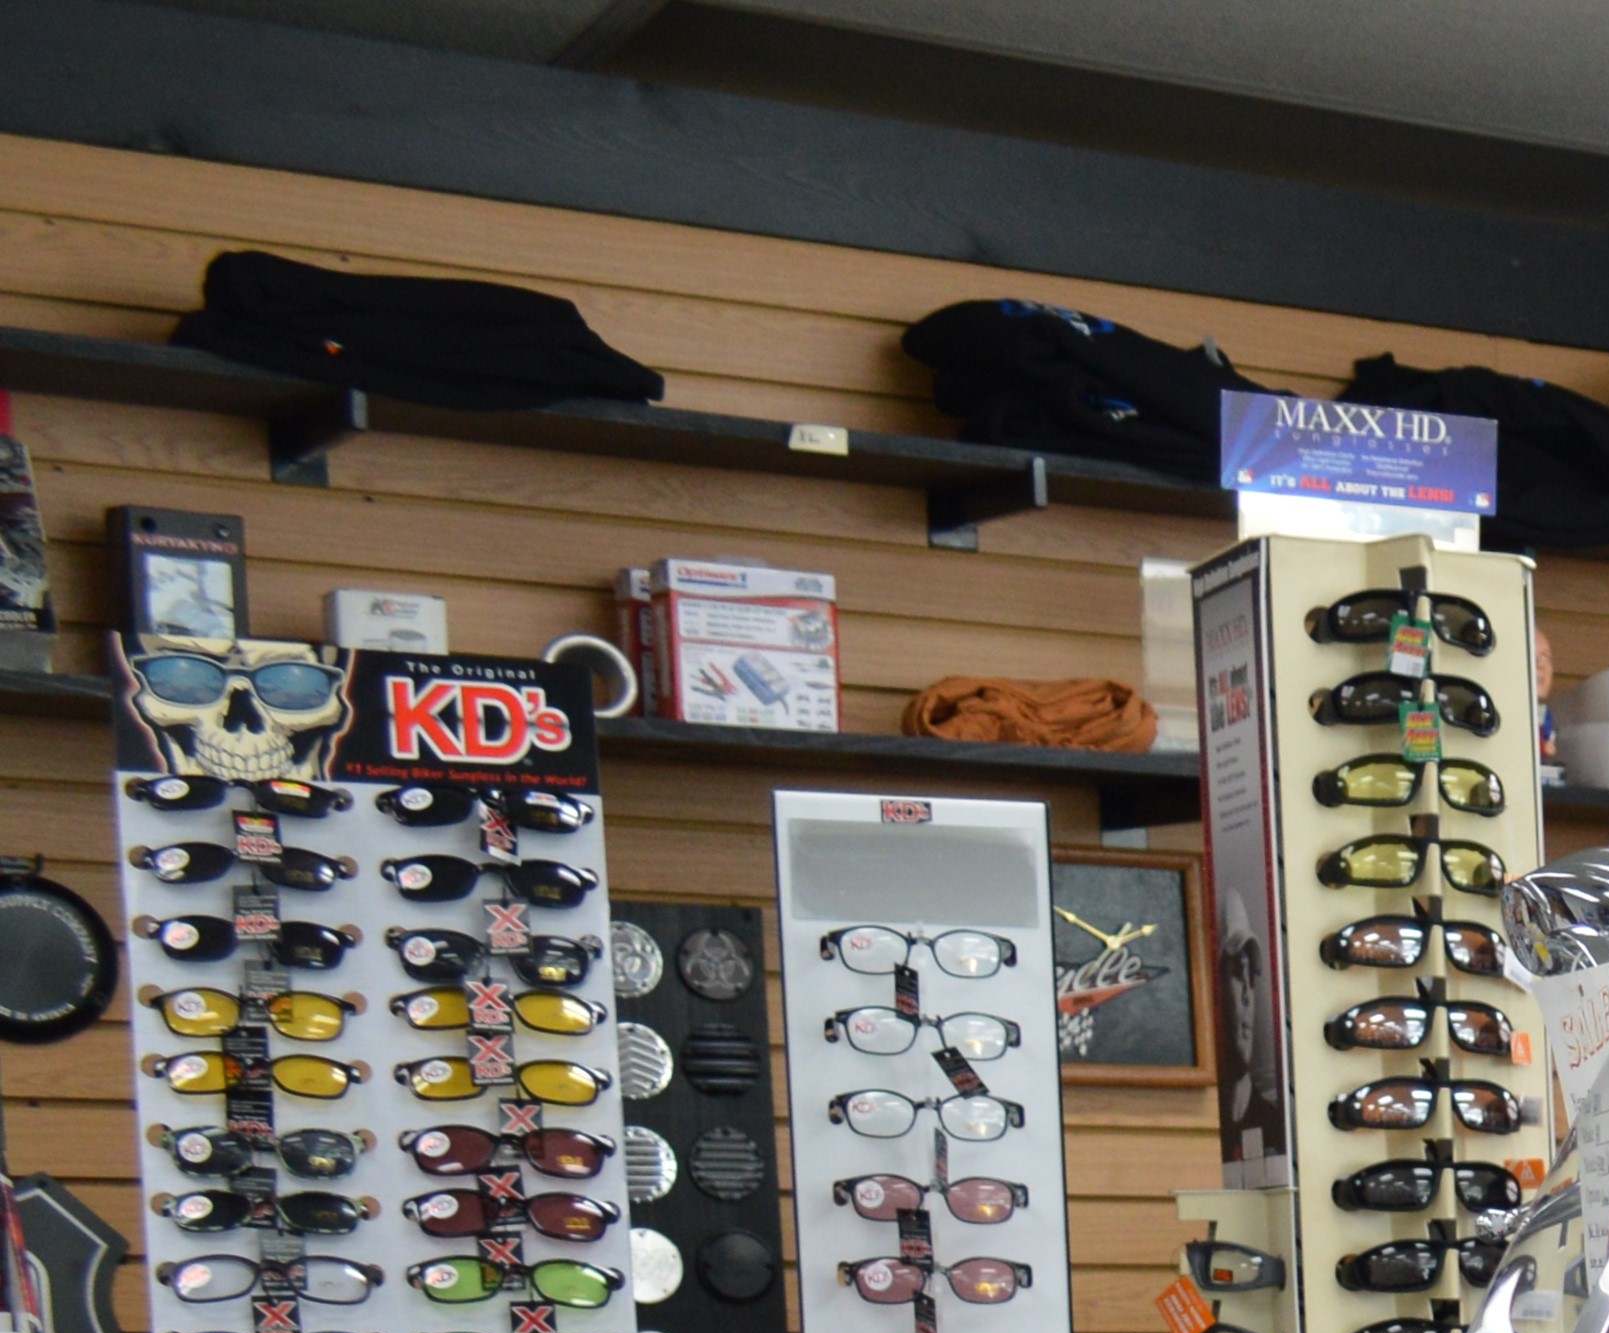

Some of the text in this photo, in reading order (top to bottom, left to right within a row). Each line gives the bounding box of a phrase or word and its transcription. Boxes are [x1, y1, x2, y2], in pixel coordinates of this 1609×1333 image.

[1275, 398, 1386, 439] MAXX
[1300, 475, 1332, 491] ALL
[1335, 481, 1379, 498] ABOUT
[405, 660, 537, 681] The Original
[385, 676, 572, 765] KD's
